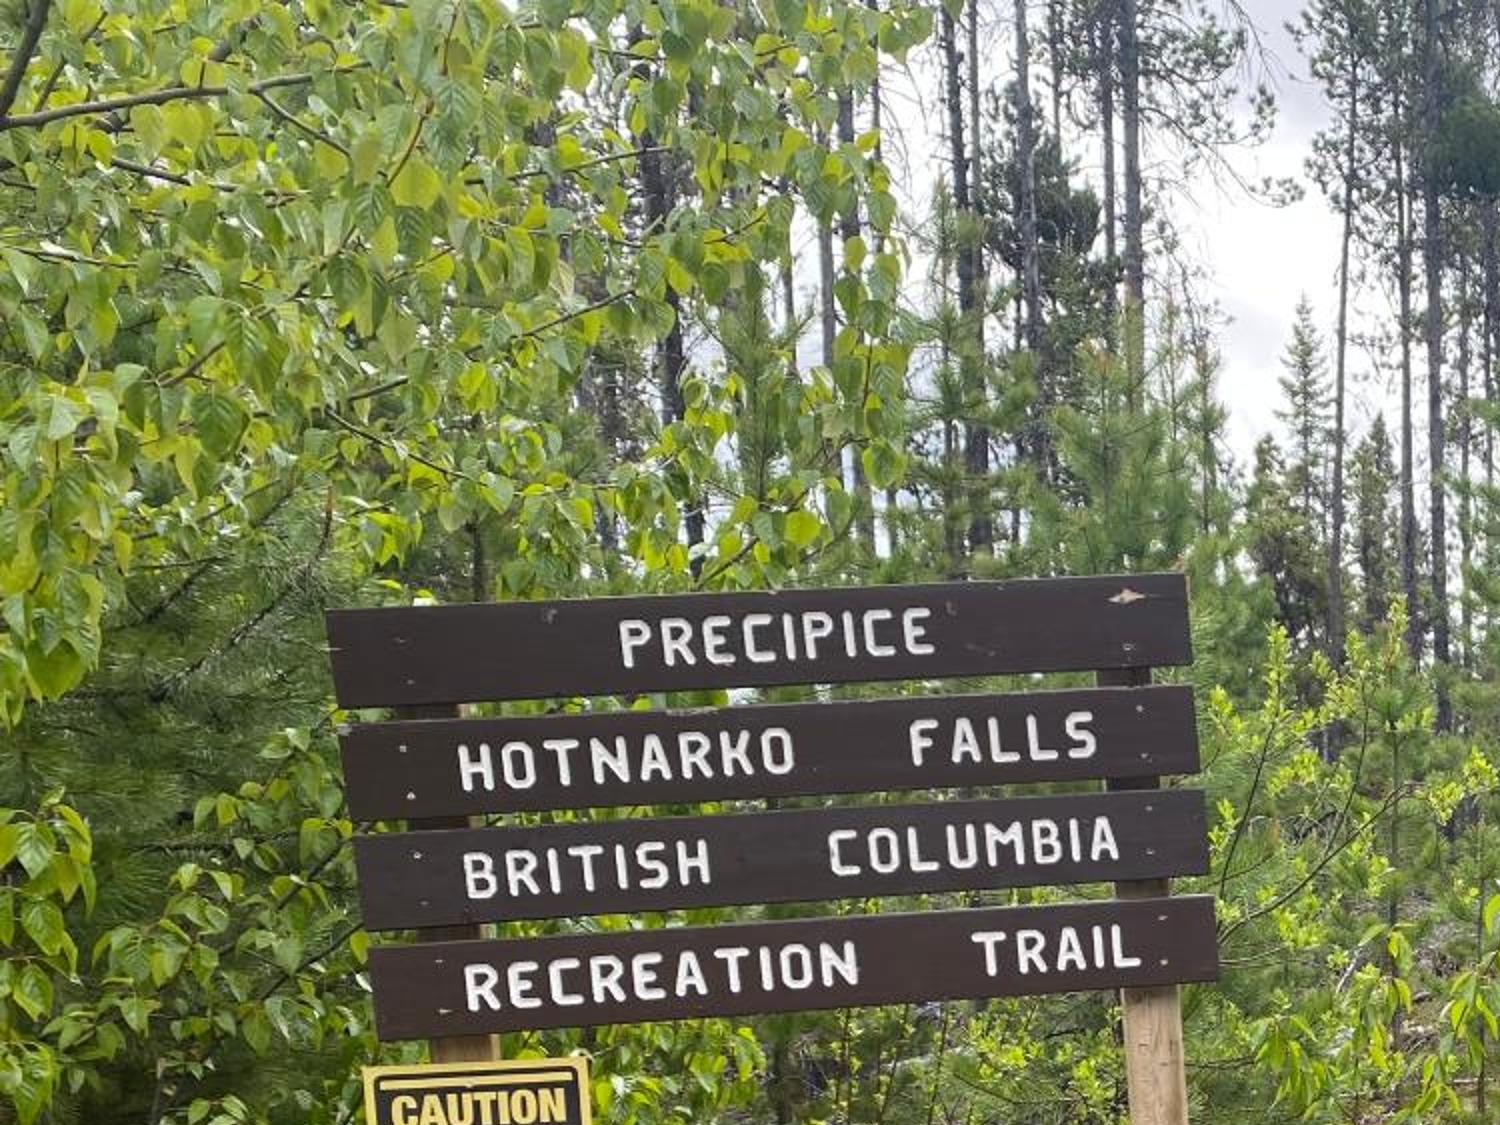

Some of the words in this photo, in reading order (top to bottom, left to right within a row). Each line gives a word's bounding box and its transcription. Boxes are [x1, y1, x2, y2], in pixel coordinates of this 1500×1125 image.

[620, 608, 934, 668] PRECIPICE
[458, 728, 794, 791] HOTNARKO
[910, 712, 1096, 766] FALLS
[464, 840, 710, 899] BRITISH
[828, 816, 1119, 876] COLUMBIA
[464, 941, 860, 1013] RECREATION
[971, 924, 1141, 976] TRAIL
